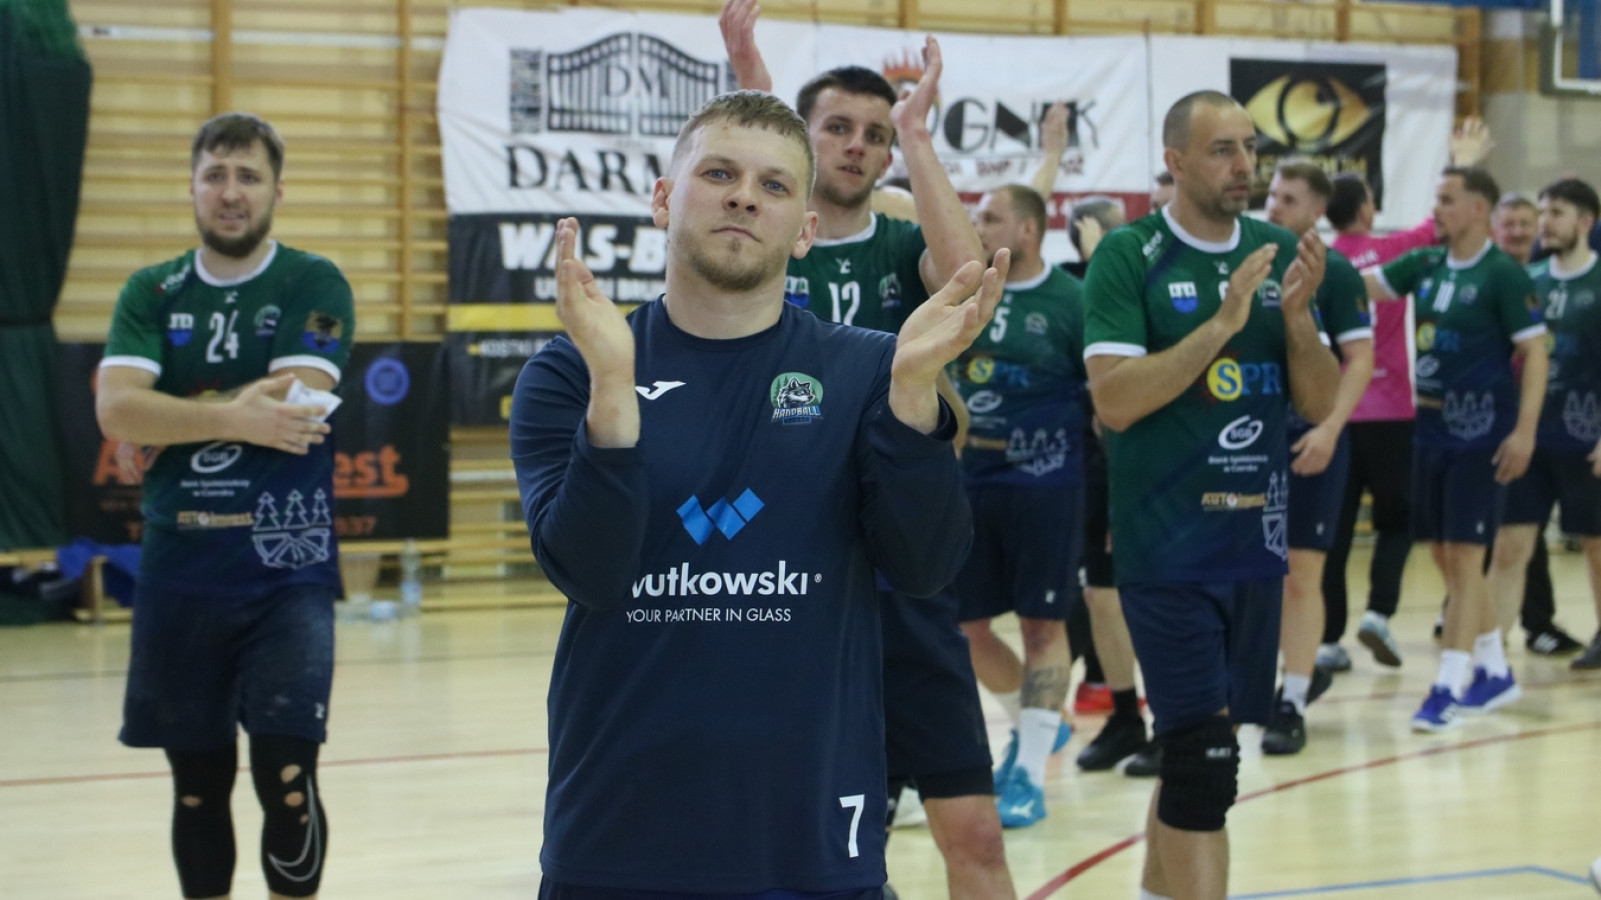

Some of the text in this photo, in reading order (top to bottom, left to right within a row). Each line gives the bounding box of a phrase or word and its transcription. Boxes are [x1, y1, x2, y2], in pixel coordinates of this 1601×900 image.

[828, 280, 861, 326] 12
[206, 310, 240, 363] 24
[989, 306, 1010, 343] 5
[1217, 362, 1282, 396] SPR
[626, 607, 792, 624] YOUR PARTNER IN GLASS
[838, 793, 865, 858] 7
